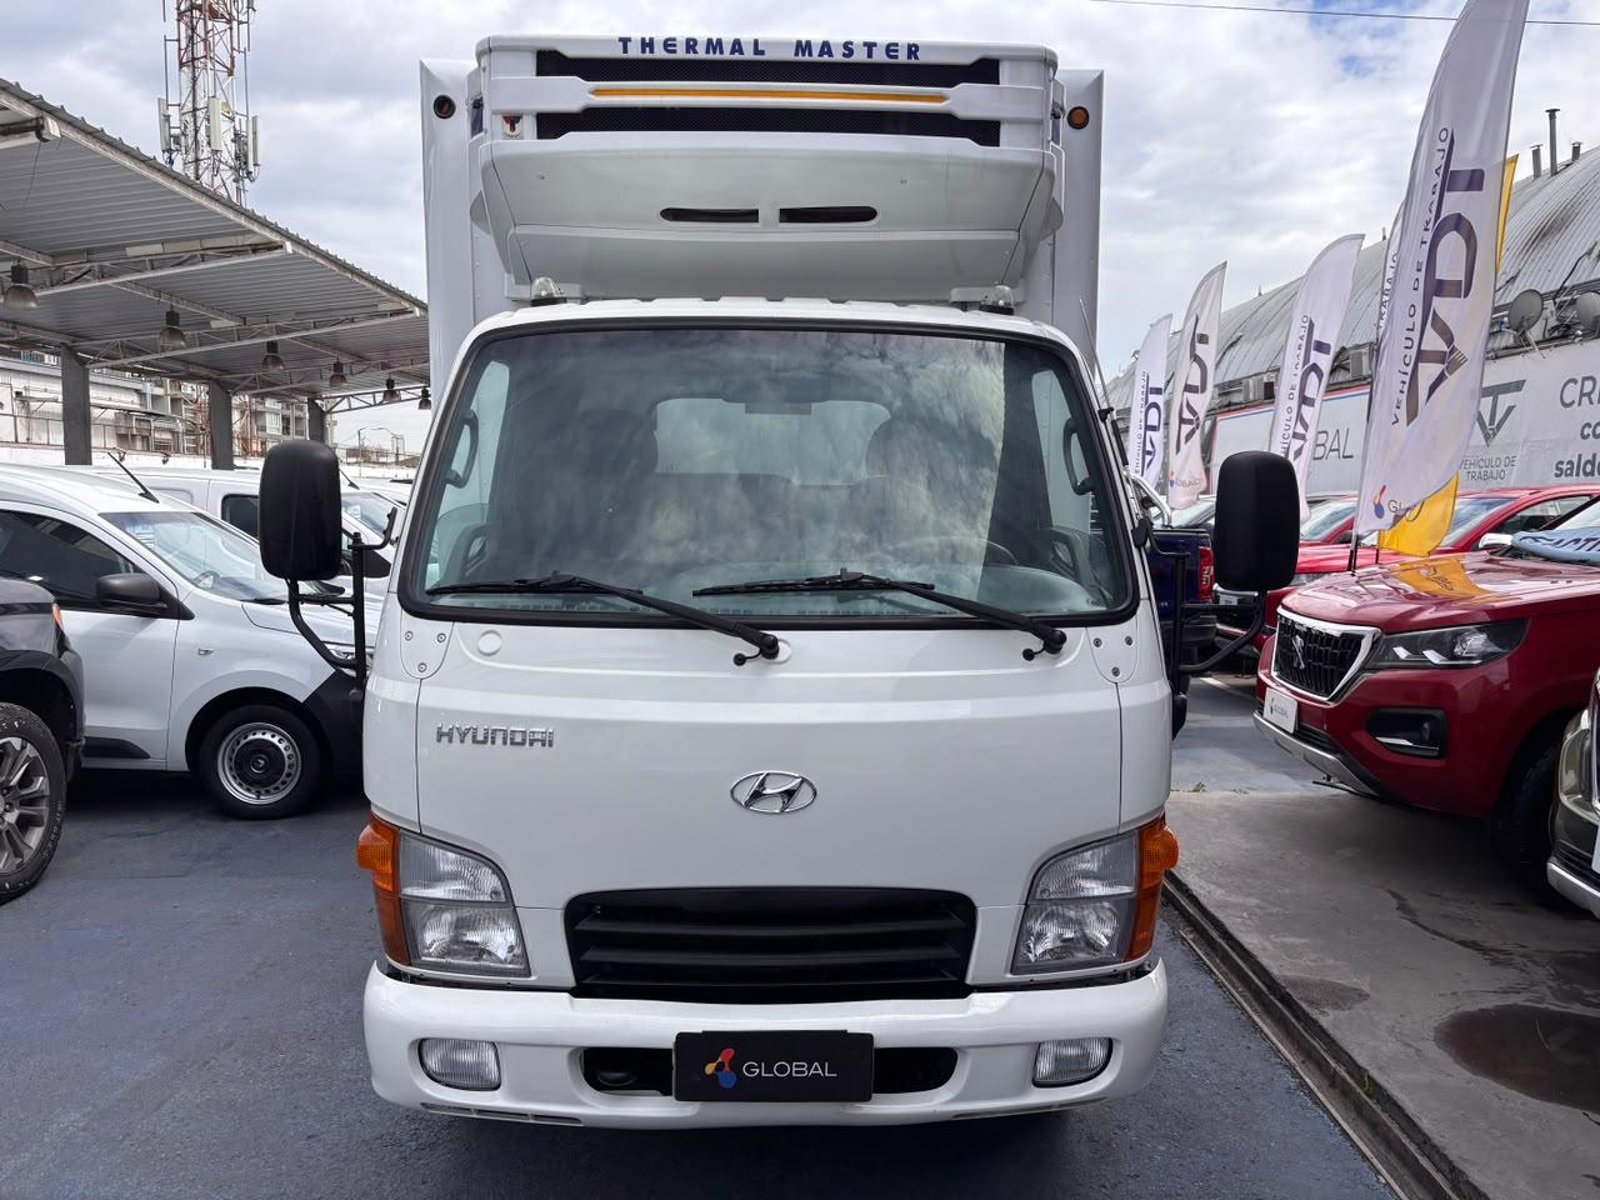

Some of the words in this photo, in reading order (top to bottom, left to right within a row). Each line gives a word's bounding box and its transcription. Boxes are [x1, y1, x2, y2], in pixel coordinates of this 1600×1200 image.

[618, 37, 765, 56] THERMAL
[794, 40, 920, 60] MASTER
[1391, 303, 1416, 425] VEHÍCULO
[1412, 260, 1424, 291] DE
[1420, 127, 1448, 248] TRABAJO
[1560, 375, 1600, 408] CR
[1313, 428, 1354, 460] BAL
[1466, 469, 1506, 481] TRABAJO
[1554, 453, 1600, 478] sald
[436, 725, 554, 748] HYUNDAI
[742, 1061, 838, 1077] GLOBAL
